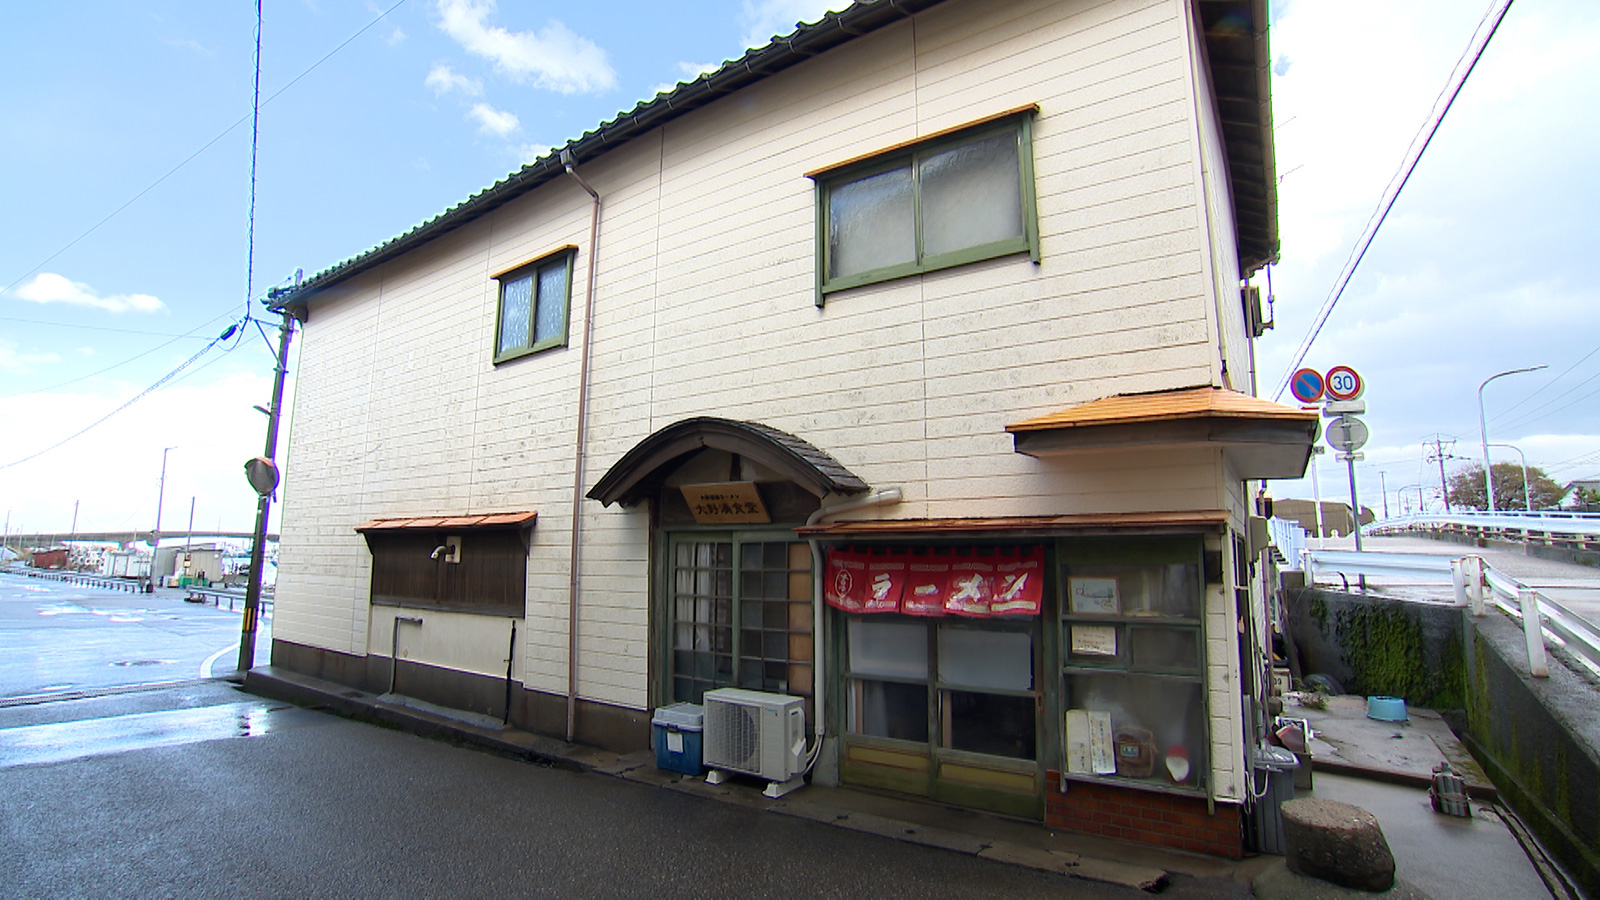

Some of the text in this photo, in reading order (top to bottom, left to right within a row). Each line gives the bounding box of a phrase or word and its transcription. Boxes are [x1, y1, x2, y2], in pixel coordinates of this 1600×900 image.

[1333, 375, 1353, 391] 30
[870, 571, 1029, 602] ラーメン
